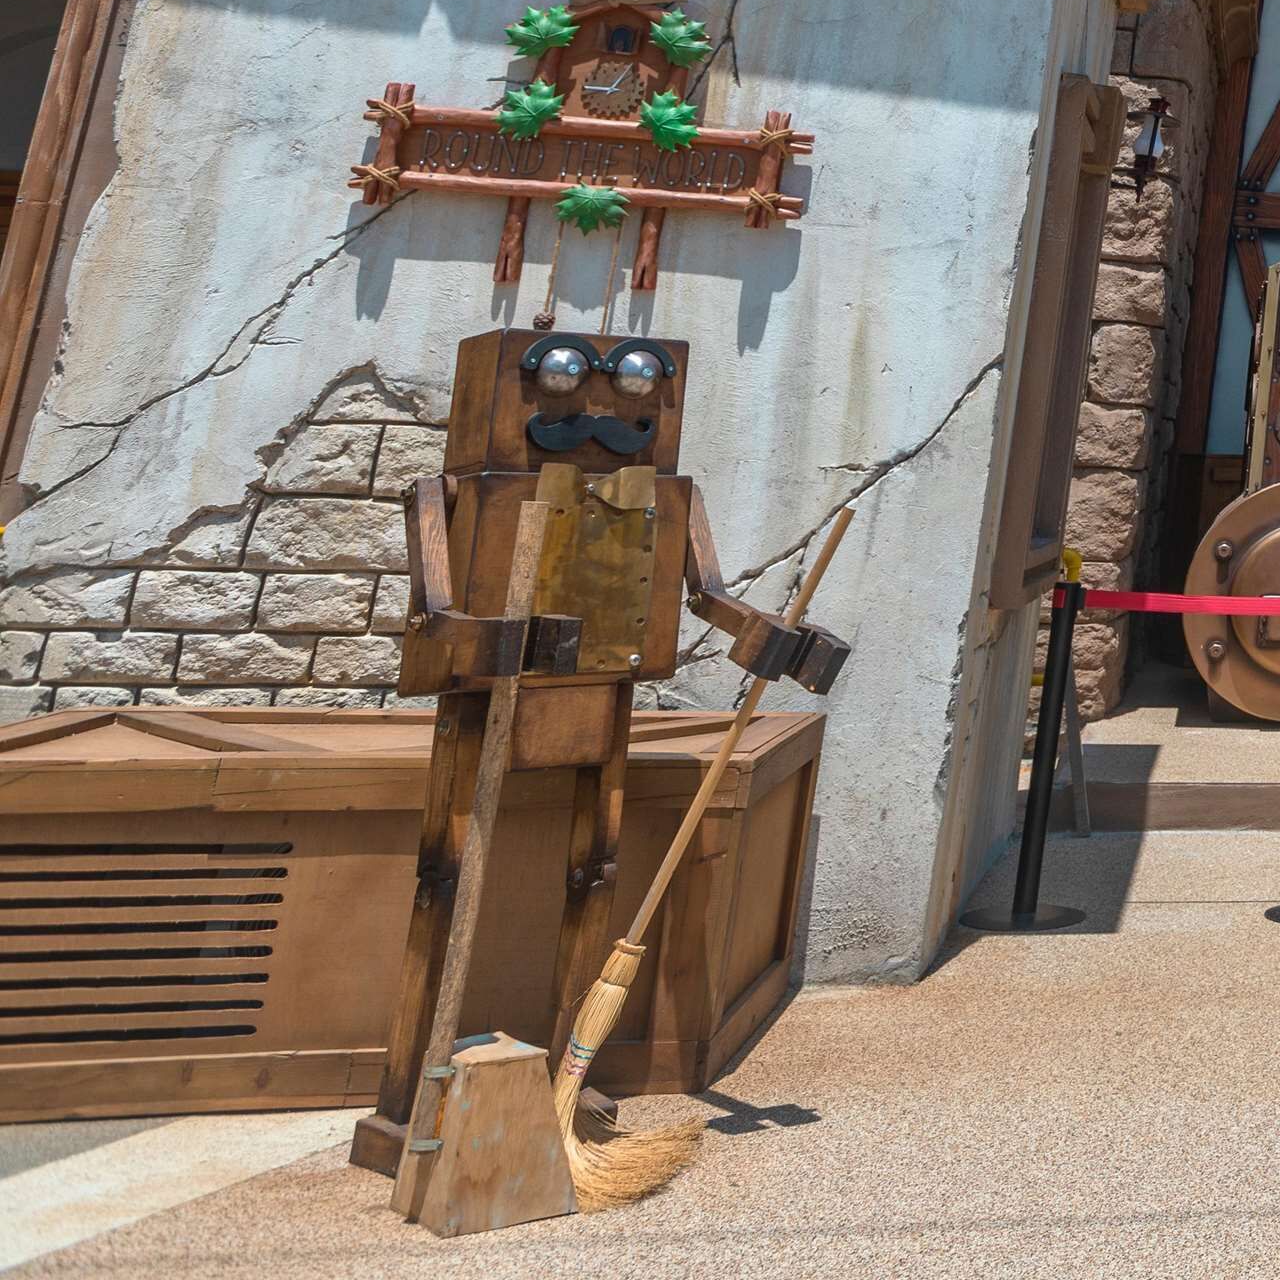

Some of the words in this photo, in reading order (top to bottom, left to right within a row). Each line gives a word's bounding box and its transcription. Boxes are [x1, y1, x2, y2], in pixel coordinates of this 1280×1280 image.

[419, 128, 545, 176] ROUND
[560, 139, 624, 180] THE
[632, 146, 745, 189] WORLD
